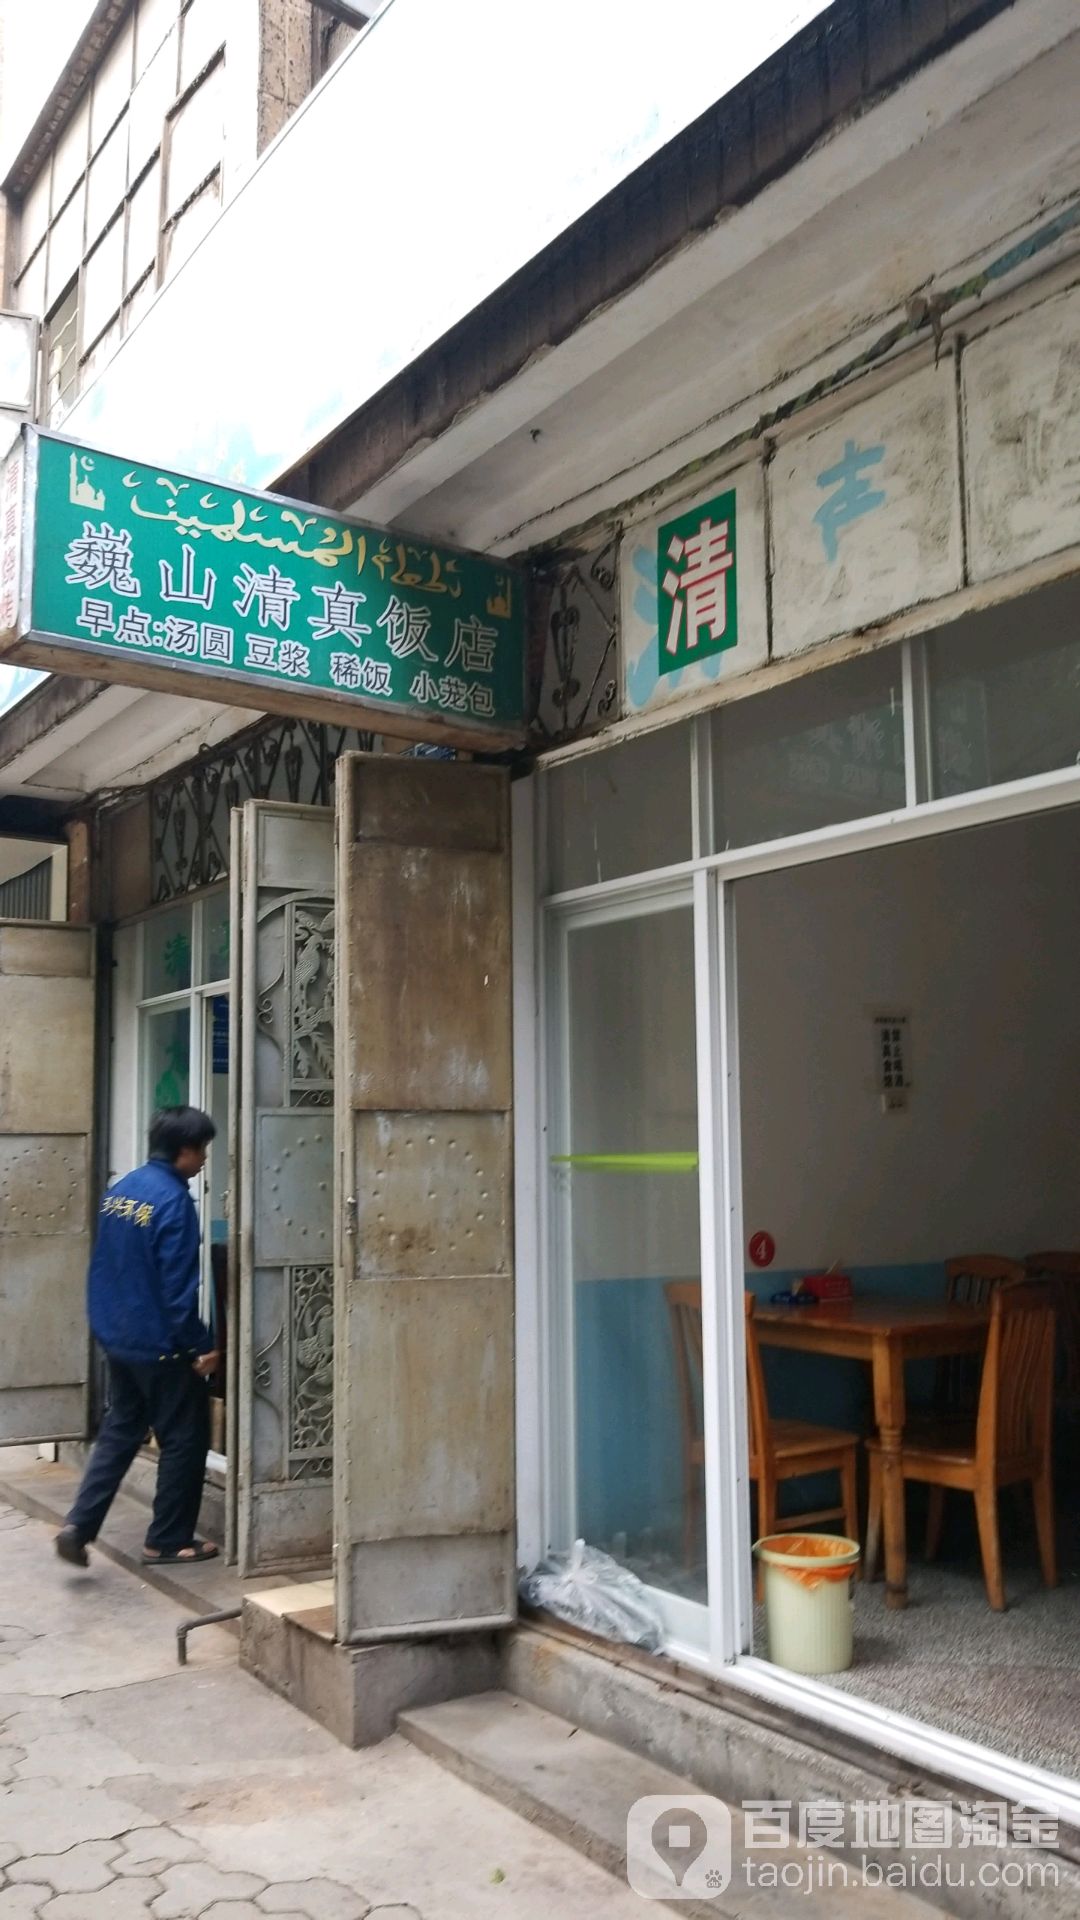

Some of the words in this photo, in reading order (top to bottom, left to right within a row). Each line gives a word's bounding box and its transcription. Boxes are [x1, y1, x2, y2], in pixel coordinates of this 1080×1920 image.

[65, 522, 499, 673] 巍山清真饭店
[662, 517, 733, 655] 清
[244, 633, 311, 677] 豆浆
[330, 652, 393, 697] 稀饭
